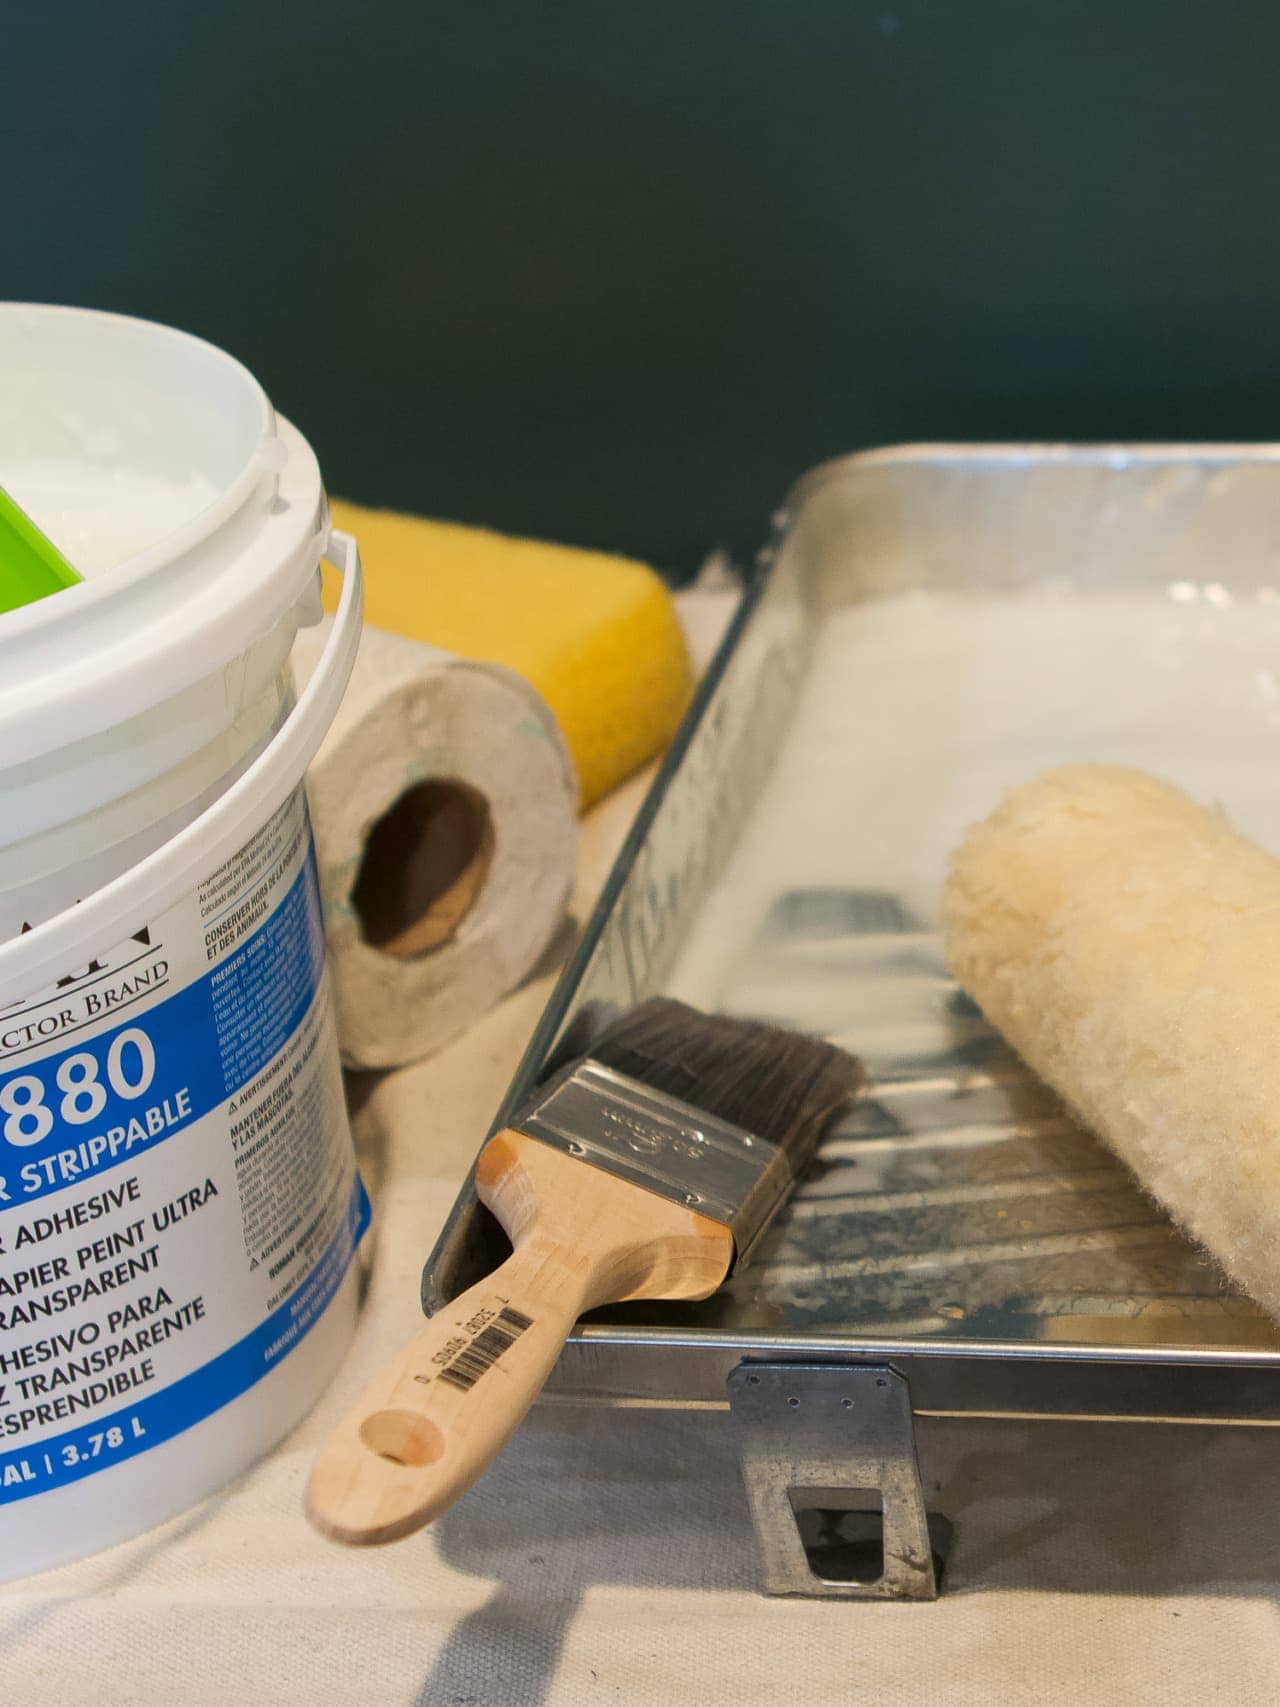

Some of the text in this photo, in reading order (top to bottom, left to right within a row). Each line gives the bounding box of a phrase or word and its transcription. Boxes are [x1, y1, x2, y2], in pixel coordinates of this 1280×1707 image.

[205, 902, 251, 946] CONSERVER
[251, 883, 269, 905] HORS
[206, 945, 218, 960] ET
[219, 934, 236, 952] DES
[0, 1009, 77, 1051] CTOR
[84, 960, 169, 1016] BRAND
[0, 1028, 155, 1147] 880
[230, 1095, 273, 1139] MANTENER
[20, 1087, 192, 1193] STRIPPABLE
[239, 1126, 256, 1146] LAS
[14, 1177, 142, 1250] ADHESIVE
[76, 1219, 146, 1270] PEINT
[151, 1177, 220, 1233] ULTRA
[107, 1287, 173, 1334] PARA
[15, 1296, 206, 1400] TRANSPARENTE
[0, 1460, 37, 1487] AL
[62, 1426, 125, 1466] 3.78
[131, 1416, 147, 1439] L
